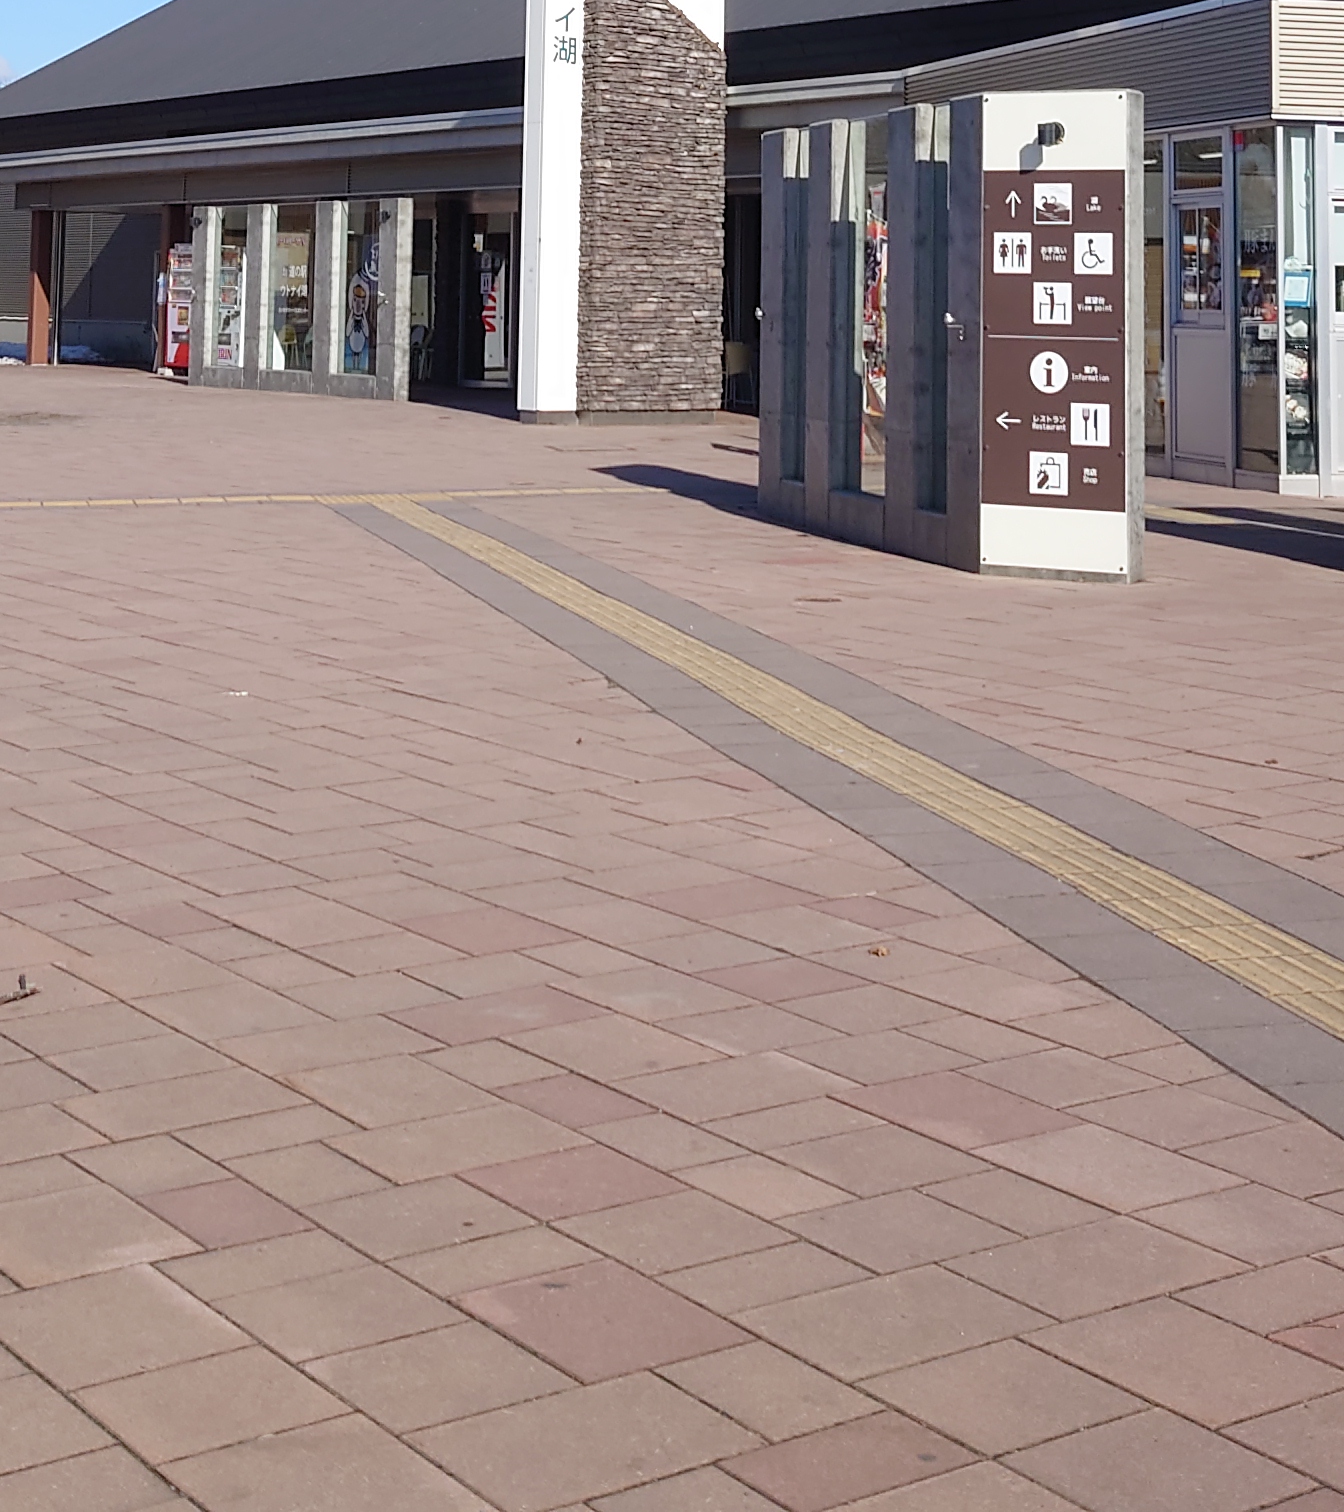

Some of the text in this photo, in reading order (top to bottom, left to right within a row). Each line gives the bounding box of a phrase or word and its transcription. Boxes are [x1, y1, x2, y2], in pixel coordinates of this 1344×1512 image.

[1071, 372, 1110, 382] Information
[1032, 414, 1066, 424] レストラン
[1031, 422, 1067, 432] Restaurant
